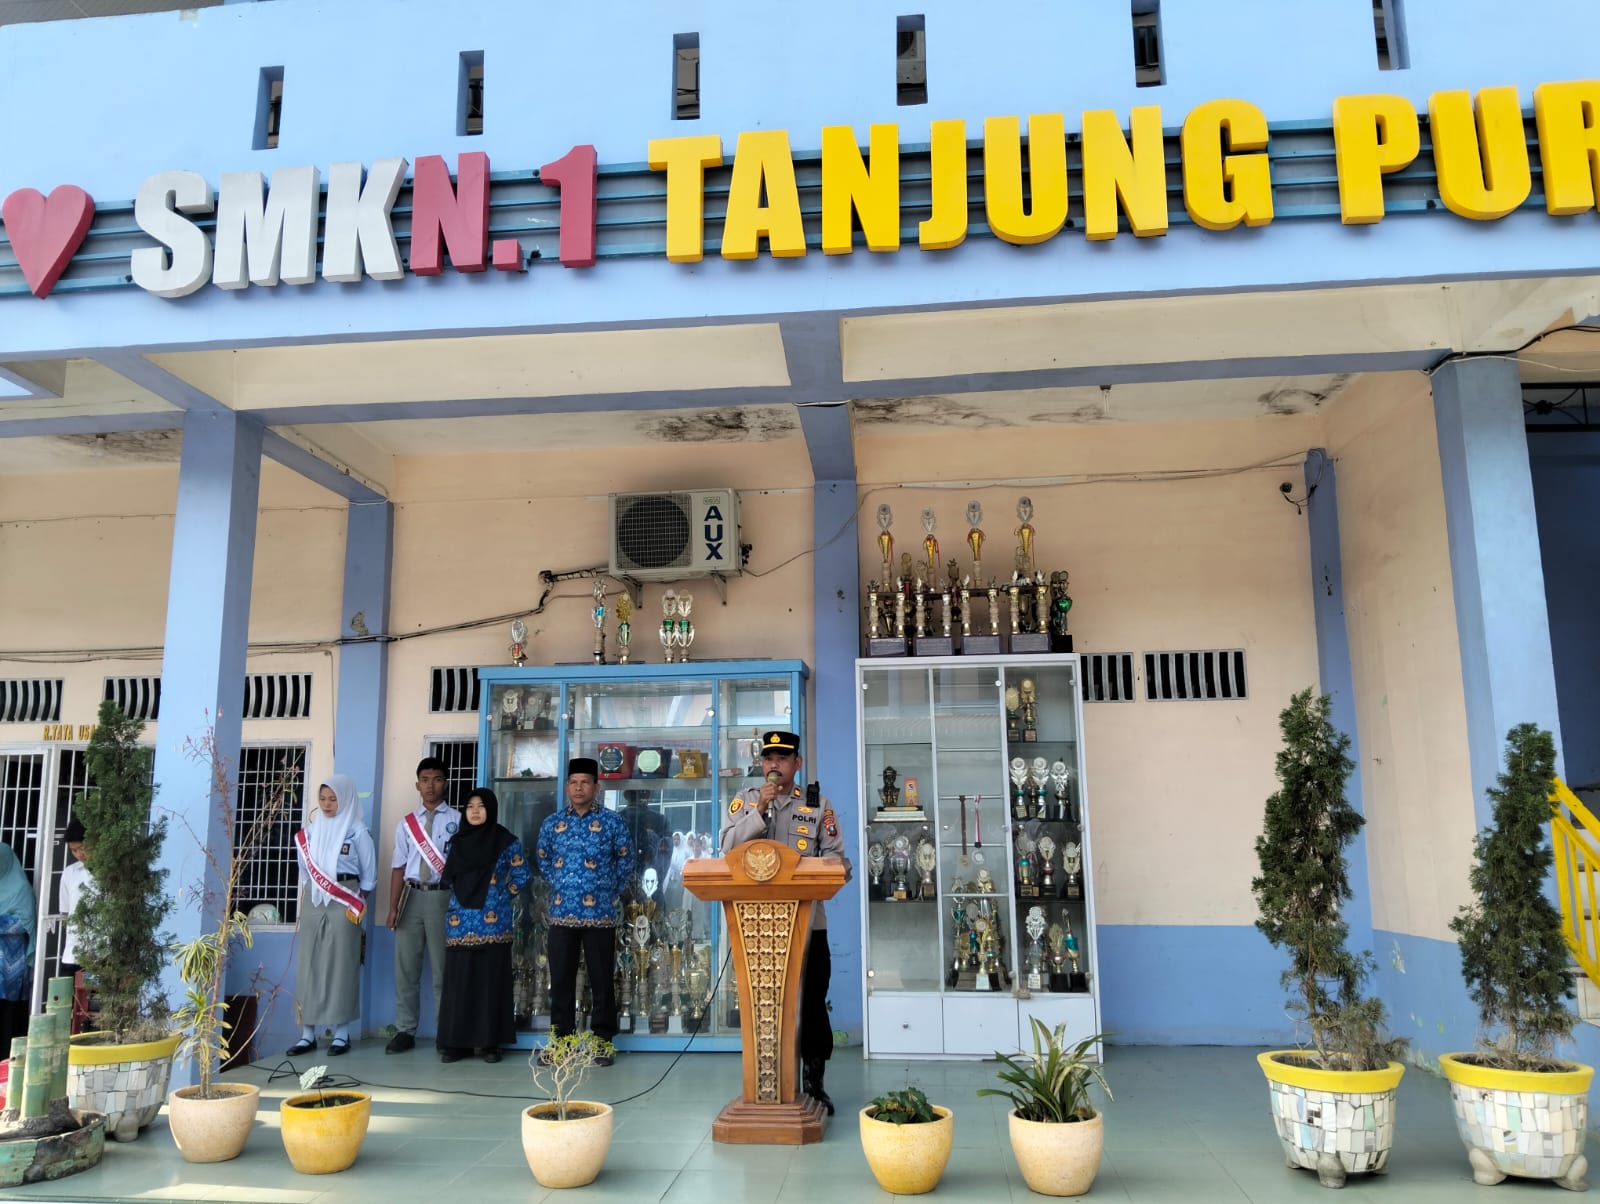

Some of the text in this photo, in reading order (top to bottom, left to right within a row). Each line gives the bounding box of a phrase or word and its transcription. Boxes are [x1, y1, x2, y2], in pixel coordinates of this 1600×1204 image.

[648, 99, 1274, 264] TANJUNG
[704, 505, 723, 560] AUX
[792, 814, 817, 824] POLRI
